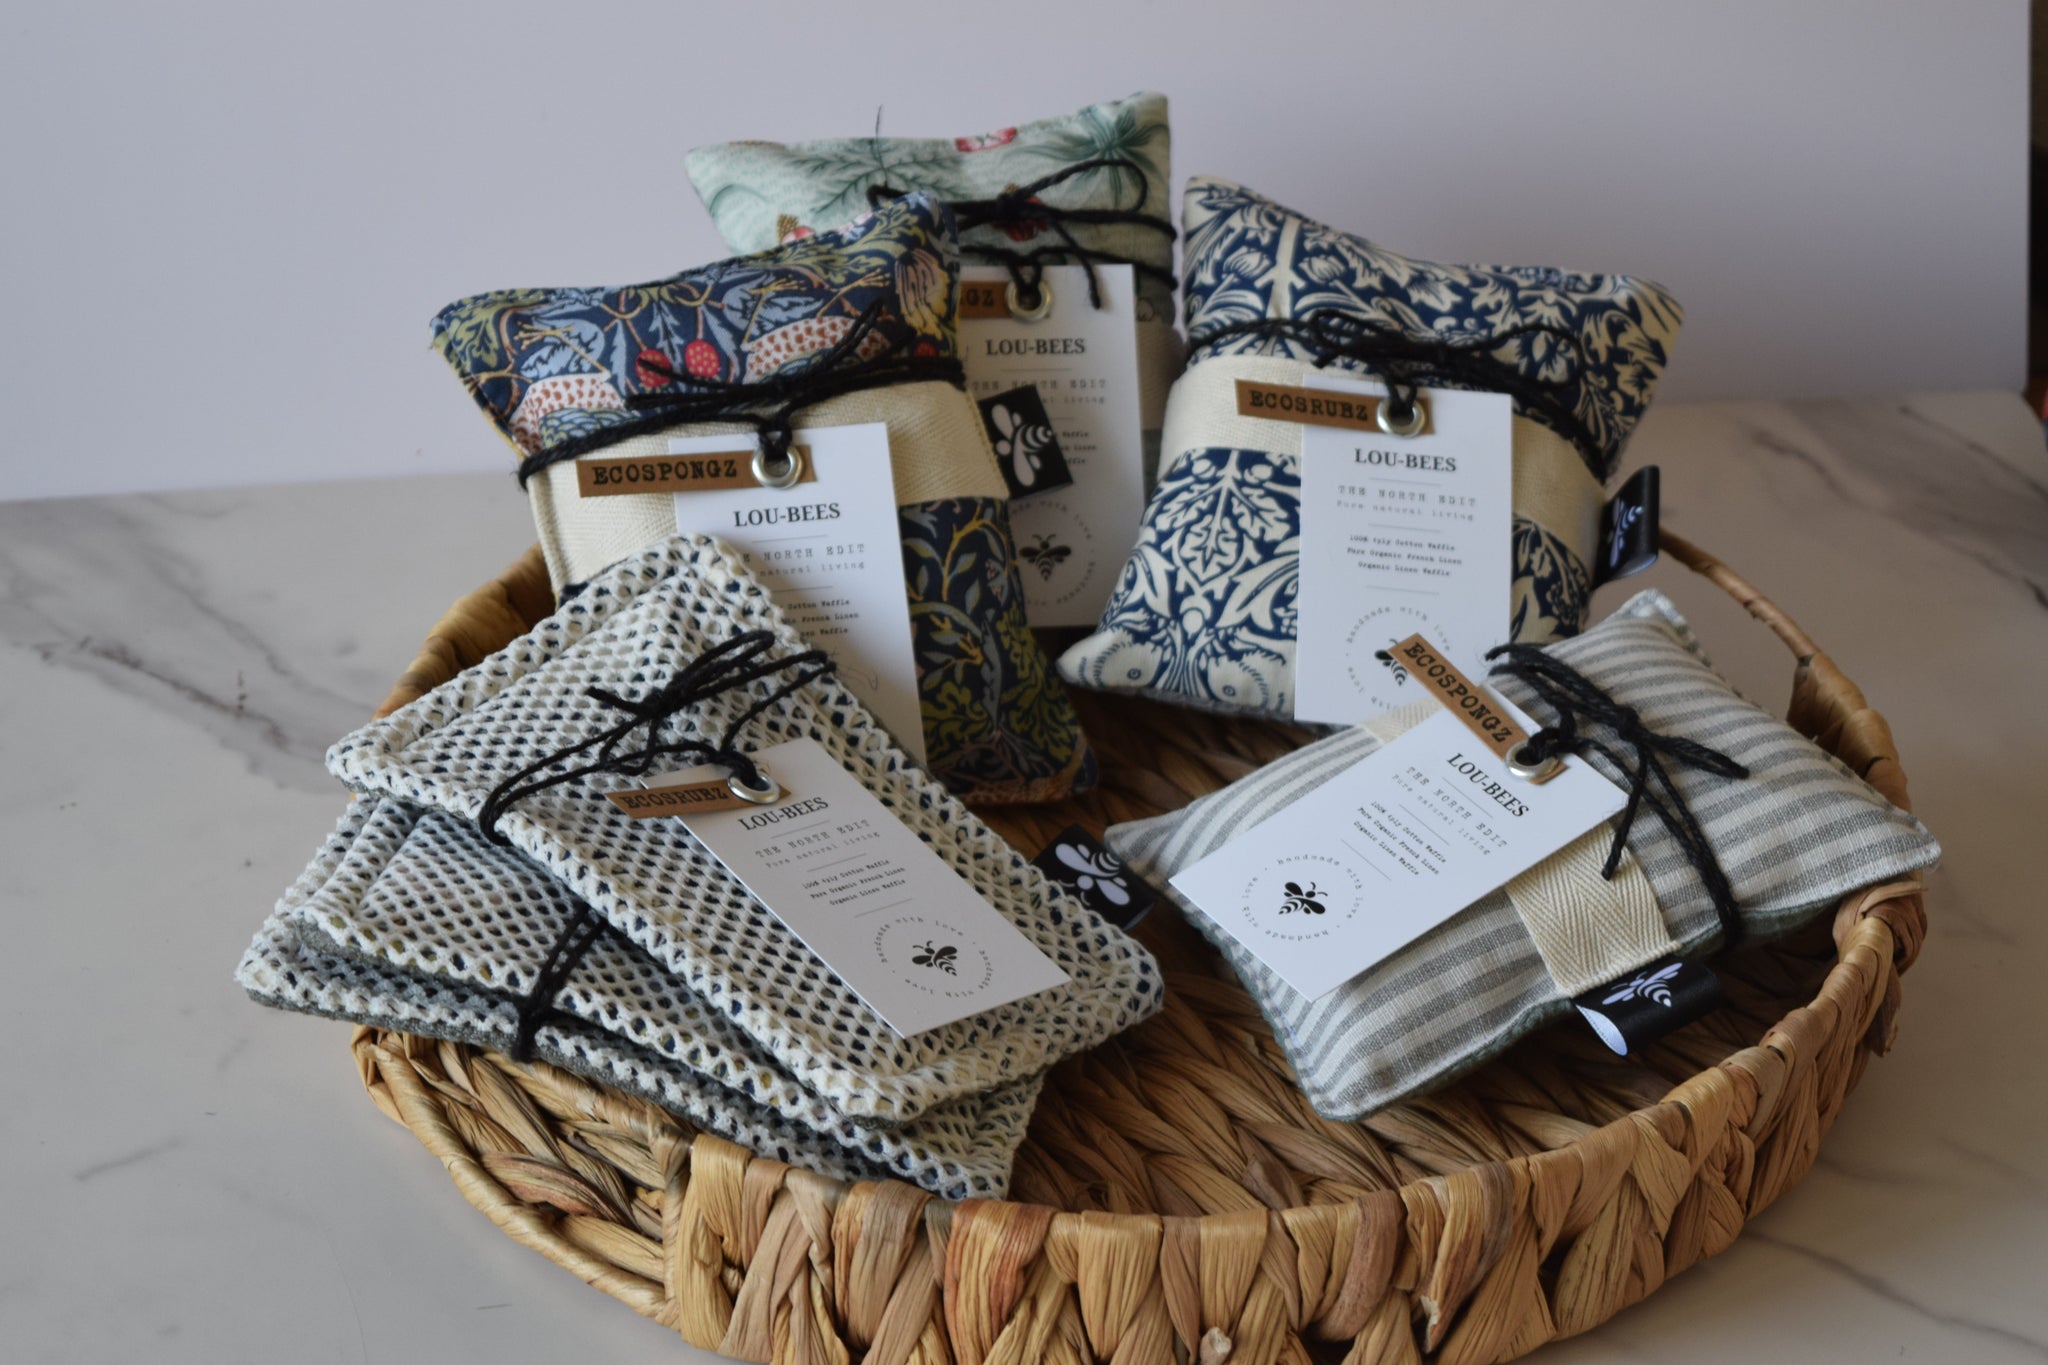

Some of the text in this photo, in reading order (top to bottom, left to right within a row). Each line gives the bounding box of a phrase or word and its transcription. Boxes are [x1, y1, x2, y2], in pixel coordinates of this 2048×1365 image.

[985, 338, 1086, 356] LOU-BEES
[1249, 389, 1368, 422] ECOSRUBZ
[592, 459, 738, 486] ECOSPONGZ
[1354, 447, 1457, 473] LOU-BEES
[1337, 484, 1476, 507] THE NORTH EDIT
[733, 502, 842, 528] LOU-BEES
[763, 548, 813, 562] NORTH
[826, 543, 866, 557] EDIT
[1403, 641, 1512, 743] ECOSPONGZ
[619, 787, 729, 809] ECOSRUBZ
[1446, 752, 1529, 818] LOU-BEES
[737, 796, 829, 831] LOU-BEES
[1406, 766, 1508, 848] THE NORTH EDIT
[754, 845, 782, 859] THE
[787, 831, 831, 849] NORTH
